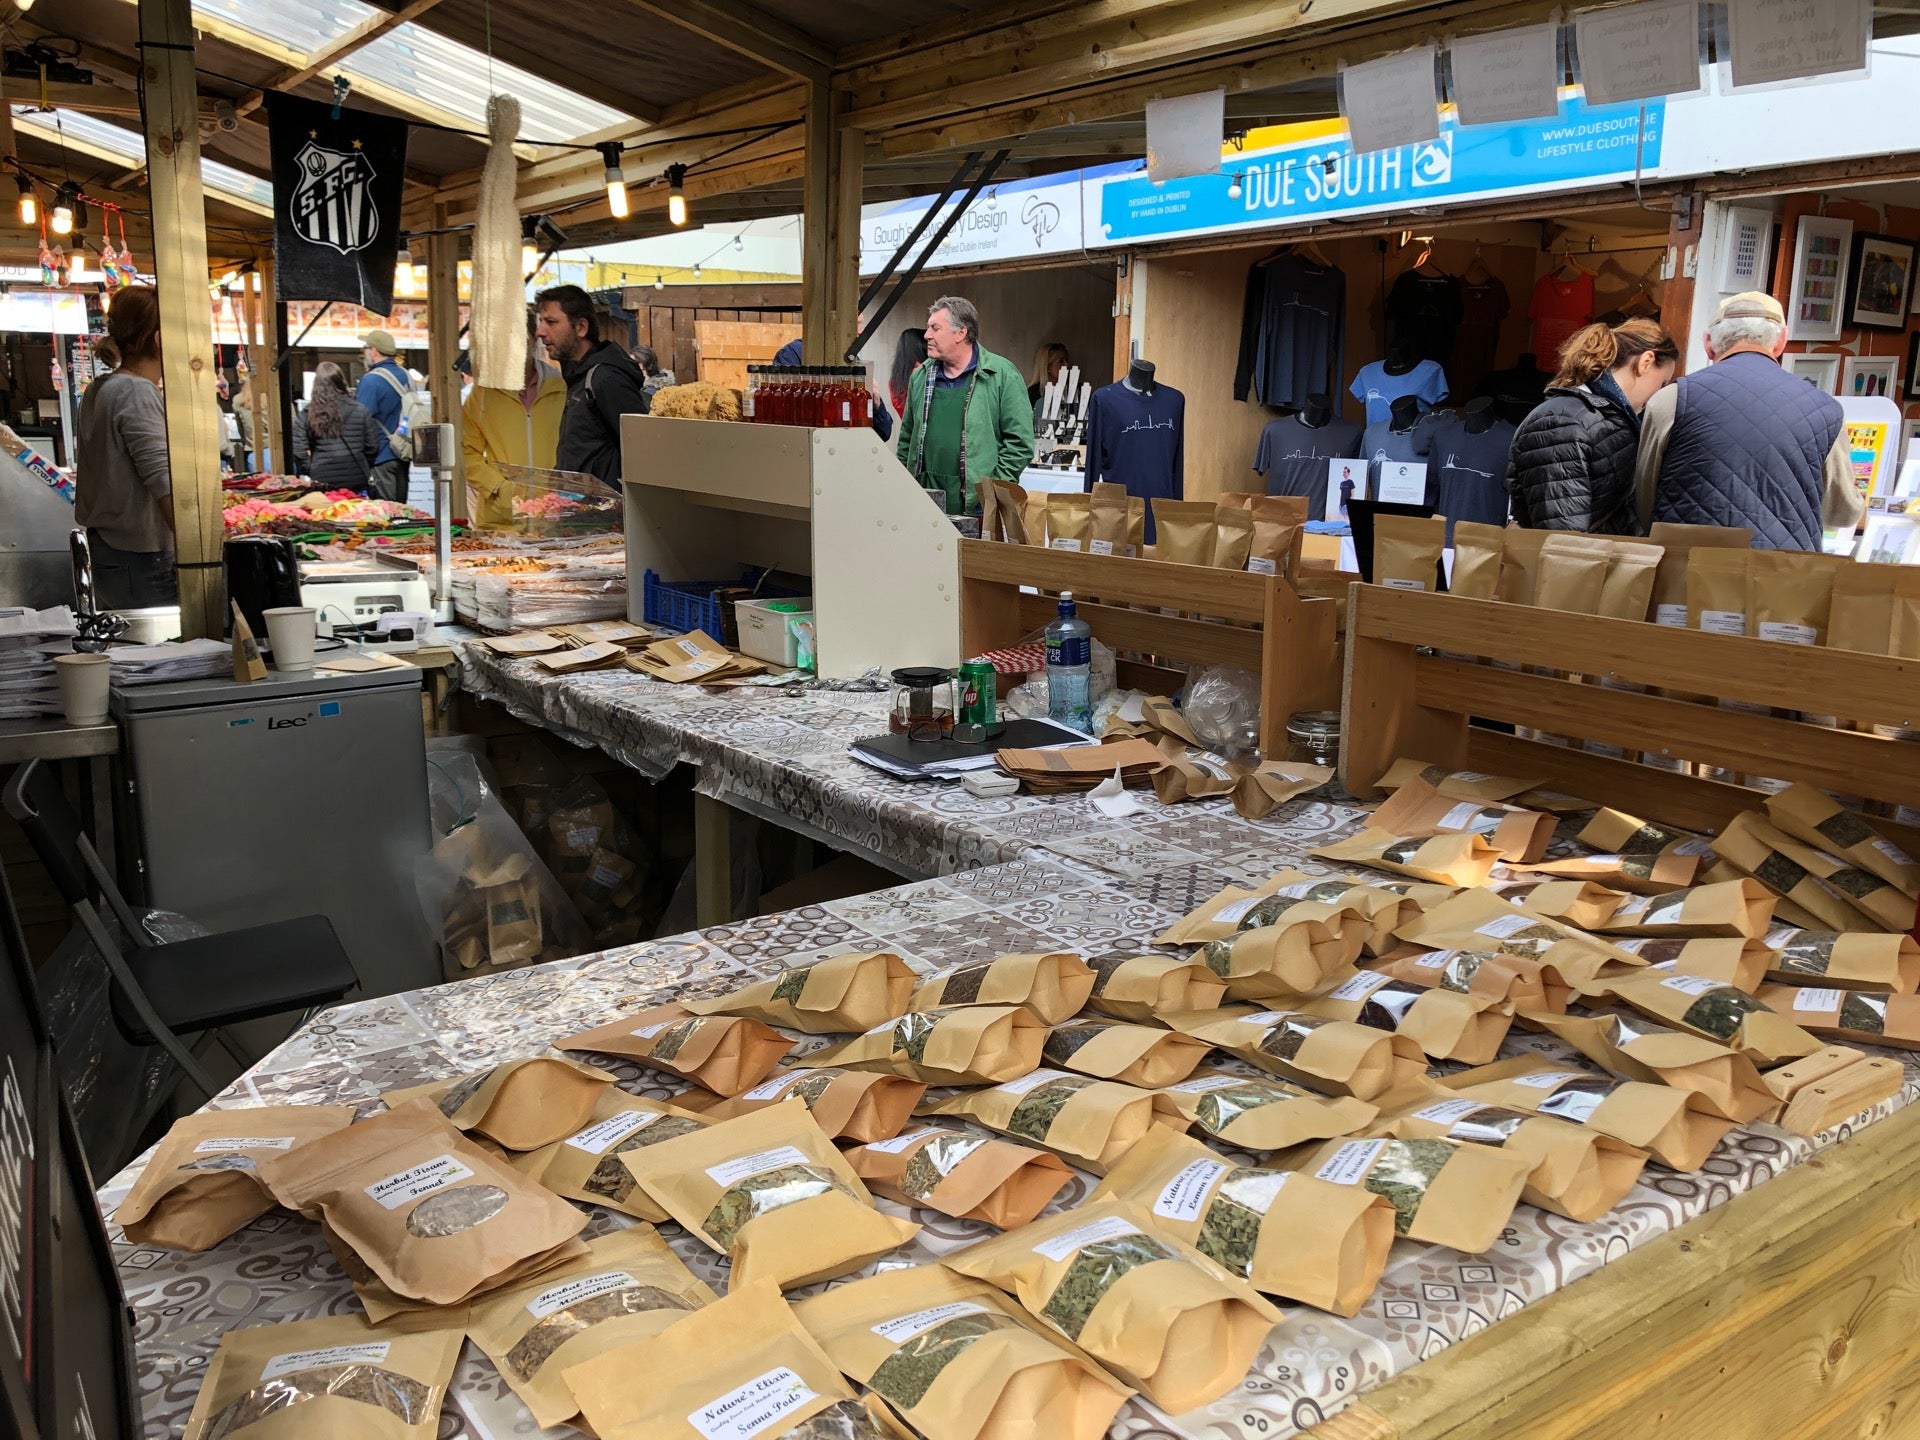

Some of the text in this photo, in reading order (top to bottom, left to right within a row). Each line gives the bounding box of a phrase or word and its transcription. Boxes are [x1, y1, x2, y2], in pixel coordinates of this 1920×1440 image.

[1537, 130, 1657, 159] LIFESTYLE CLOTHING
[1245, 147, 1401, 211] DUE SOUTH
[1128, 190, 1191, 207] DESIGNED & PRINTED
[967, 211, 1008, 232] Design
[1131, 203, 1187, 219] BY HAND IN DUBLIN
[959, 241, 977, 252] Dublin
[977, 239, 998, 250] Ireland
[32, 464, 53, 485] VIDAL
[267, 716, 307, 730] Lec
[576, 1122, 611, 1142] Nature's
[601, 1128, 625, 1143] Senna
[373, 1160, 449, 1194] Herbal Tisane
[409, 1178, 447, 1196] Fennel
[1188, 1181, 1208, 1211] Lemon
[539, 1273, 625, 1302] Herbal Tisane
[705, 1371, 791, 1424] Nature's Elixir
[737, 1392, 801, 1435] Senna Pods
